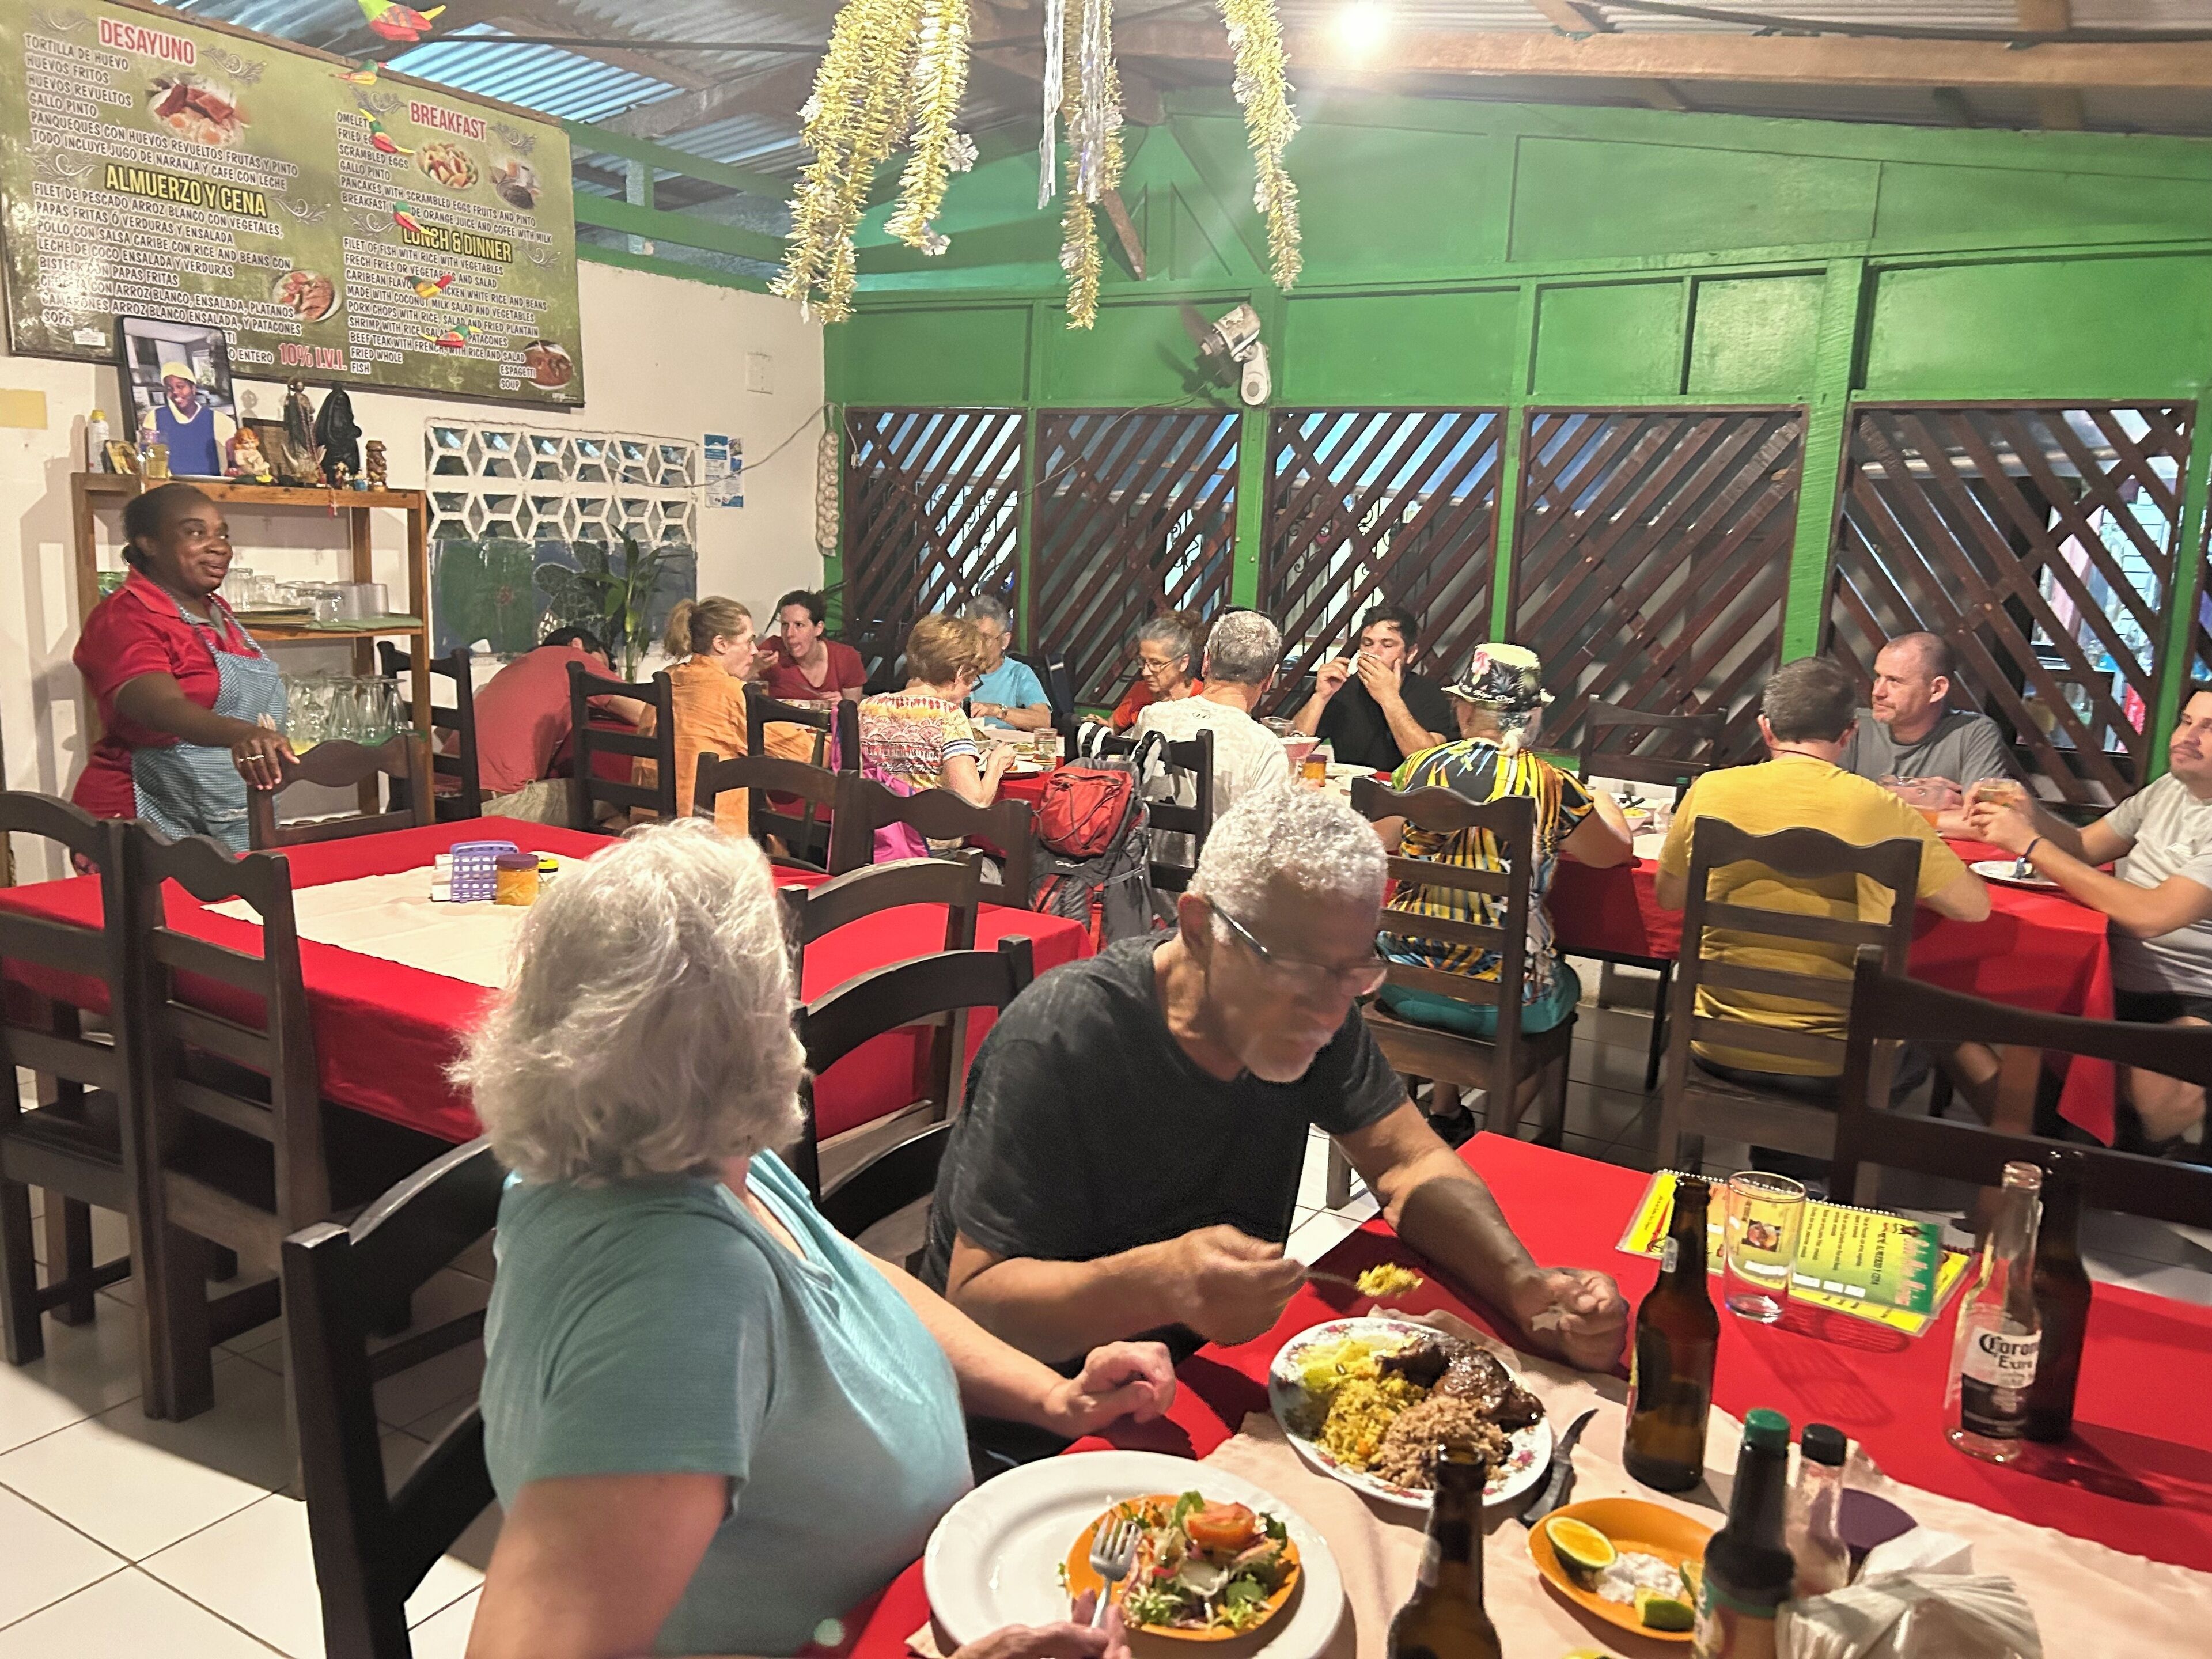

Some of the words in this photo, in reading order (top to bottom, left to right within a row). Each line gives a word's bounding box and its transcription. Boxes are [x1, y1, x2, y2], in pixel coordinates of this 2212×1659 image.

[25, 34, 74, 59] TORTILLA
[78, 46, 90, 62] DE
[94, 50, 128, 71] HUEVO
[100, 19, 195, 65] DESAYUNO
[26, 54, 69, 75] HUEVOS
[73, 65, 109, 84] FRITOS
[28, 72, 70, 94] HUEVOS
[75, 82, 132, 107] REVUELTOS
[29, 91, 63, 111] GALLO
[66, 99, 97, 118] PINTO
[338, 127, 361, 143] FRIED
[411, 103, 486, 139] BREAKFAST
[30, 109, 100, 137] PANQUEQUES
[103, 125, 124, 142] CON
[128, 130, 168, 150] HUEVOS
[171, 139, 222, 161] REVUELTOS
[225, 150, 260, 169] FRUTAS
[262, 158, 269, 171] Y
[271, 160, 298, 176] PINTO
[31, 128, 61, 146] TODO
[63, 135, 107, 156] INCLUYE
[109, 144, 137, 161] JUGO
[139, 150, 153, 164] DE
[155, 153, 200, 173] NARANJA
[202, 162, 208, 175] Y
[211, 164, 233, 180] CAFE
[236, 169, 256, 184] CON
[259, 174, 286, 190] LECHE
[339, 143, 385, 165] SCRAMBLED
[388, 154, 409, 170] EGGS
[339, 160, 365, 175] GALLO
[367, 165, 391, 180] PINTO
[105, 162, 202, 206] ALMUERZO
[203, 181, 217, 209] Y
[219, 184, 268, 218] CENA
[340, 176, 382, 196] PANCAKES
[384, 185, 403, 200] WITH
[406, 190, 450, 209] SCRAMBLED
[452, 199, 471, 214] EGGS
[473, 203, 497, 219] FRUITS
[499, 209, 514, 222] AND
[516, 212, 536, 226] PINTO
[33, 181, 61, 199] FILET
[65, 187, 78, 202] DE
[81, 190, 128, 210] PESCADO
[131, 199, 164, 216] ARROZ
[168, 205, 204, 223] BLANCO
[207, 212, 226, 227] CON
[230, 216, 283, 238] VEGETALES,
[36, 200, 69, 218] PAPAS
[73, 207, 108, 225] FRITAS
[111, 210, 119, 226] Ó
[122, 215, 173, 235] VERDURAS
[177, 224, 183, 237] Y
[185, 226, 233, 245] ENSALADA
[342, 191, 387, 212] BREAKFAST
[423, 207, 453, 225] ORANGE
[456, 214, 475, 229] JUICE
[477, 218, 491, 232] AND
[493, 221, 515, 236] COFEE
[518, 226, 534, 240] WITH
[536, 230, 552, 243] MILK
[37, 218, 70, 236] POLLO
[73, 224, 95, 240] CON
[99, 228, 131, 245] SALSA
[133, 234, 168, 251] CARIBE
[172, 240, 191, 255] CON
[194, 244, 214, 258] RICE
[217, 247, 236, 262] AND
[240, 251, 270, 267] BEANS
[272, 256, 291, 270] CON
[37, 236, 70, 254] LECHE
[74, 242, 88, 256] DE
[91, 244, 119, 261] COCO
[122, 249, 171, 269] ENSALADA
[174, 257, 181, 270] Y
[184, 259, 233, 278] VERDURAS
[344, 237, 365, 252] FILET
[368, 241, 377, 254] OF
[379, 243, 396, 257] FISH
[398, 247, 418, 261] WITH
[420, 250, 438, 264] RICE
[440, 253, 459, 268] WITH
[460, 257, 503, 275] VEGETABLES
[403, 221, 449, 252] LUNCH
[451, 230, 461, 254] &
[462, 232, 512, 263] DINNER
[112, 266, 143, 282] PAPAS
[146, 271, 179, 287] FRITAS
[344, 253, 371, 269] FRECH
[373, 258, 395, 272] FRIES
[396, 262, 408, 275] OR
[458, 272, 472, 285] AND
[474, 274, 497, 289] SALAD
[346, 268, 386, 286] CARIBEAN
[467, 287, 489, 302] WHITE
[491, 291, 507, 304] RICE
[509, 294, 524, 307] AND
[525, 296, 547, 310] BEANS
[90, 280, 112, 294] CON
[116, 283, 150, 300] ARROZ
[153, 289, 191, 306] BLANCO,
[195, 294, 247, 314] ENSALADA,
[250, 302, 294, 319] PLATANOS
[112, 300, 145, 315] ARROZ
[149, 305, 186, 320] BLANCO
[189, 310, 241, 329] ENSALADA,
[243, 317, 249, 328] Y
[252, 319, 301, 335] PATACONES
[347, 285, 370, 300] MADE
[372, 288, 391, 302] WITH
[431, 297, 449, 310] MILK
[450, 300, 474, 314] SALAD
[475, 303, 490, 316] AND
[491, 305, 535, 323] VEGETABLES
[347, 301, 371, 315] PORK
[372, 304, 397, 318] CHOPS
[399, 308, 418, 320] WITH
[421, 310, 441, 324] RICE,
[442, 313, 465, 327] SALAD
[467, 317, 482, 329] AND
[483, 319, 504, 332] FRIED
[506, 322, 538, 336] PLANTAIN
[349, 316, 380, 331] SHRIMP
[382, 320, 402, 334] WITH
[467, 331, 507, 347] PATACONES
[238, 350, 274, 363] ENTERO
[279, 343, 313, 366] 10%
[315, 347, 347, 370] I.V.I.
[350, 331, 371, 345] BEEF
[372, 334, 393, 347] TEAK
[393, 336, 412, 350] WITH
[468, 345, 483, 358] RICE
[486, 347, 501, 359] AND
[502, 349, 525, 362] SALAD
[351, 347, 374, 359] FRIED
[376, 350, 403, 363] WHOLE
[351, 362, 369, 373] FISH
[500, 364, 536, 378] ESPAGETTI
[500, 380, 520, 389] SOUP
